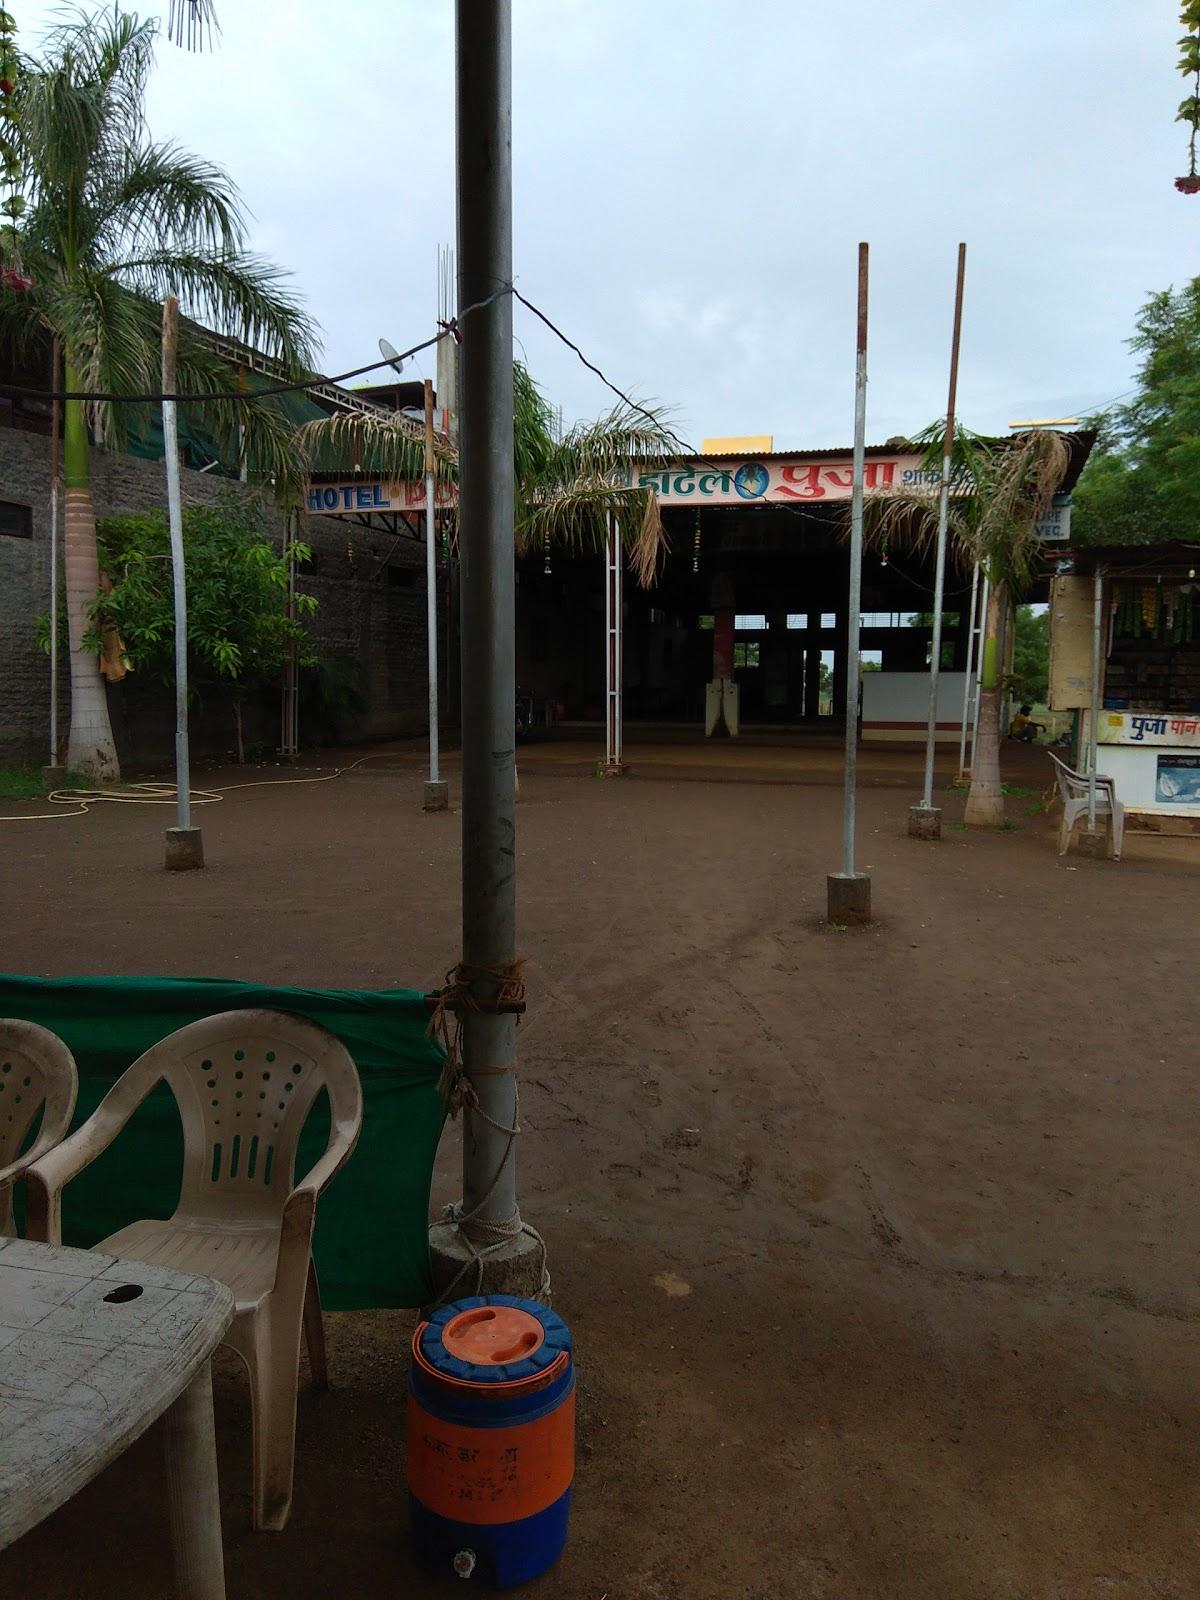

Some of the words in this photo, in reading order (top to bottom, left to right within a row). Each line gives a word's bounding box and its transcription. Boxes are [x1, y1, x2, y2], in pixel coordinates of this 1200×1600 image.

[774, 462, 898, 498] पुजा
[308, 485, 391, 511] HOTEL
[1130, 716, 1169, 740] पुजा
[1171, 719, 1198, 735] पान
